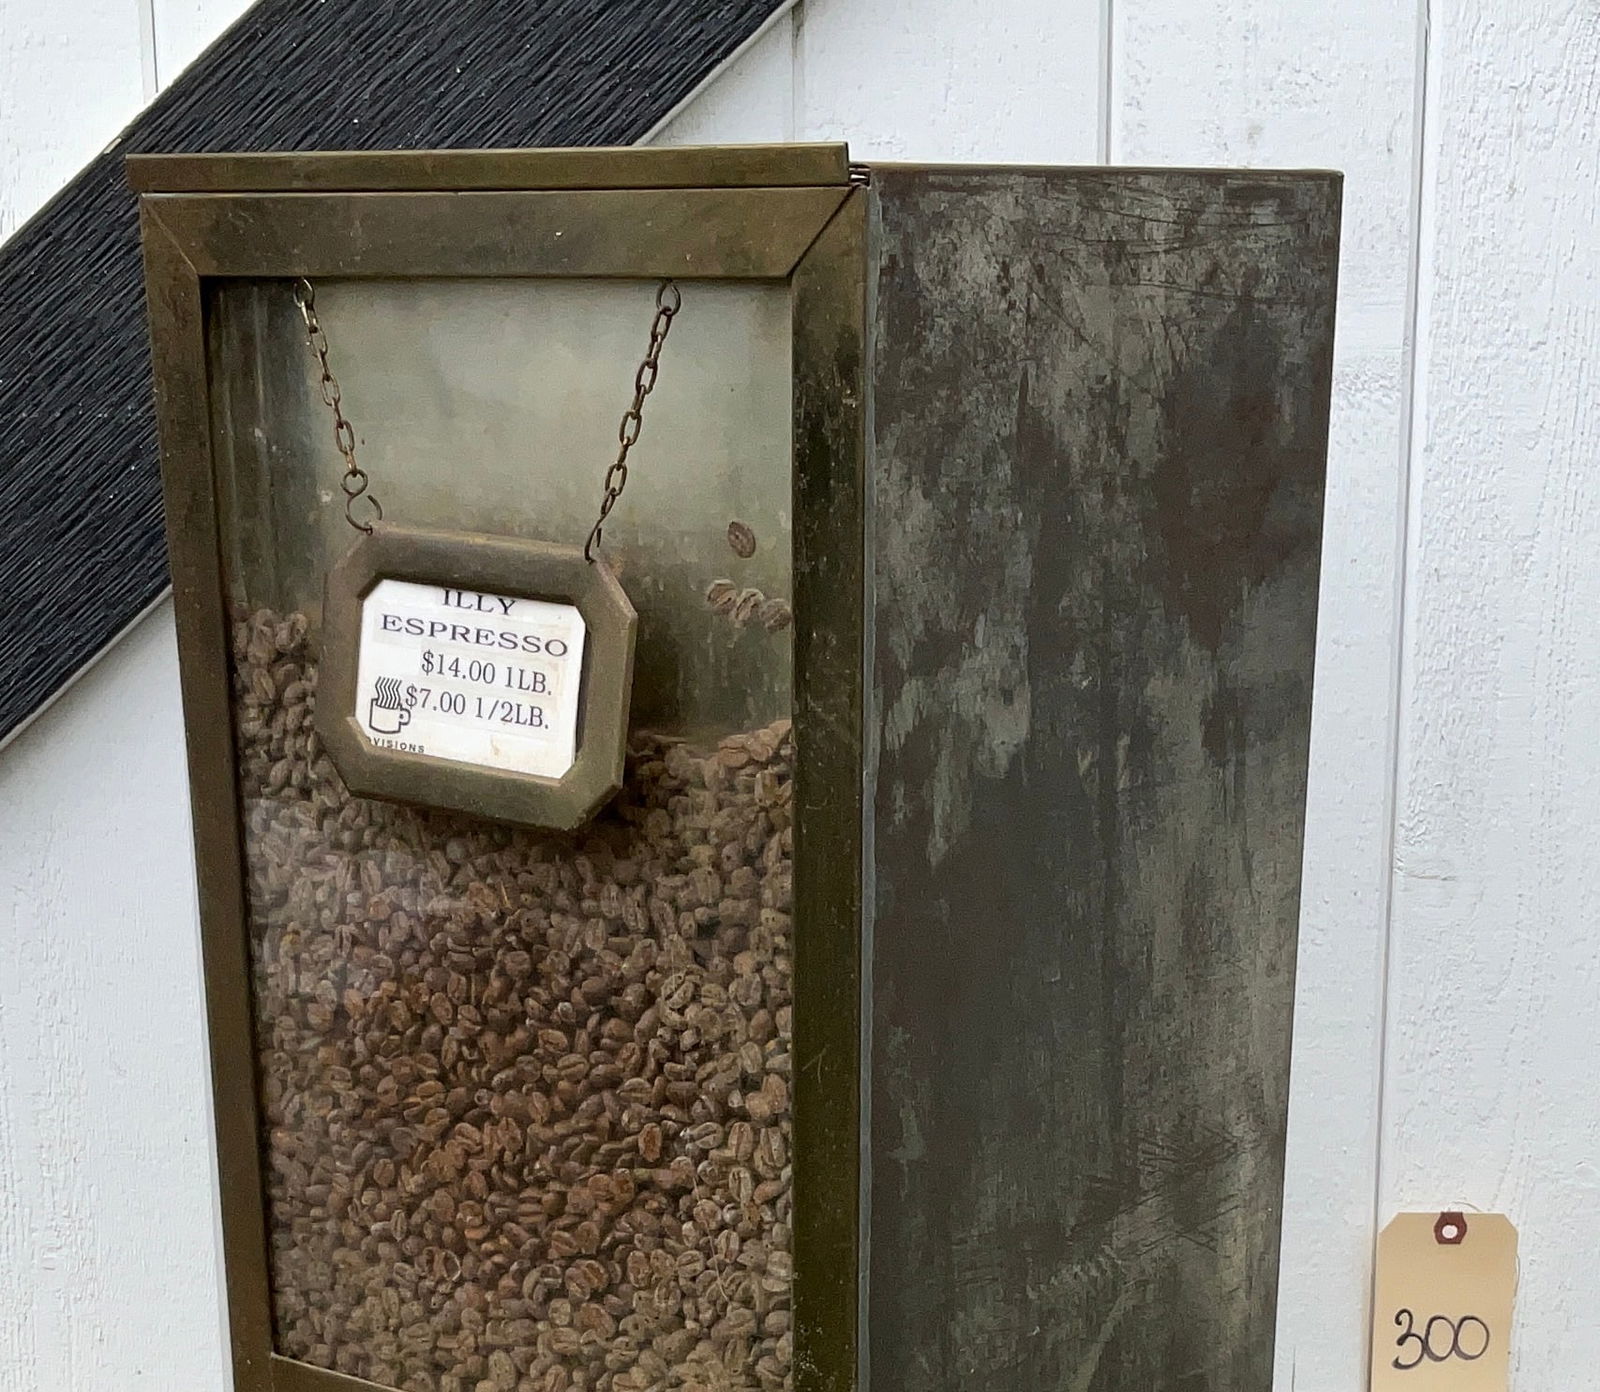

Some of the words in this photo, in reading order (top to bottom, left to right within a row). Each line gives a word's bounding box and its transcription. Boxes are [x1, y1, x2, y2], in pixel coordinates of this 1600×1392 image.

[442, 589, 517, 616] ILLY
[381, 614, 568, 657] ESPRESSO
[421, 650, 496, 684] $14.00
[506, 666, 552, 696] 1LB.
[405, 683, 466, 715] $7.00
[475, 698, 549, 729] 1/2LB.
[1392, 1308, 1490, 1370] 300
